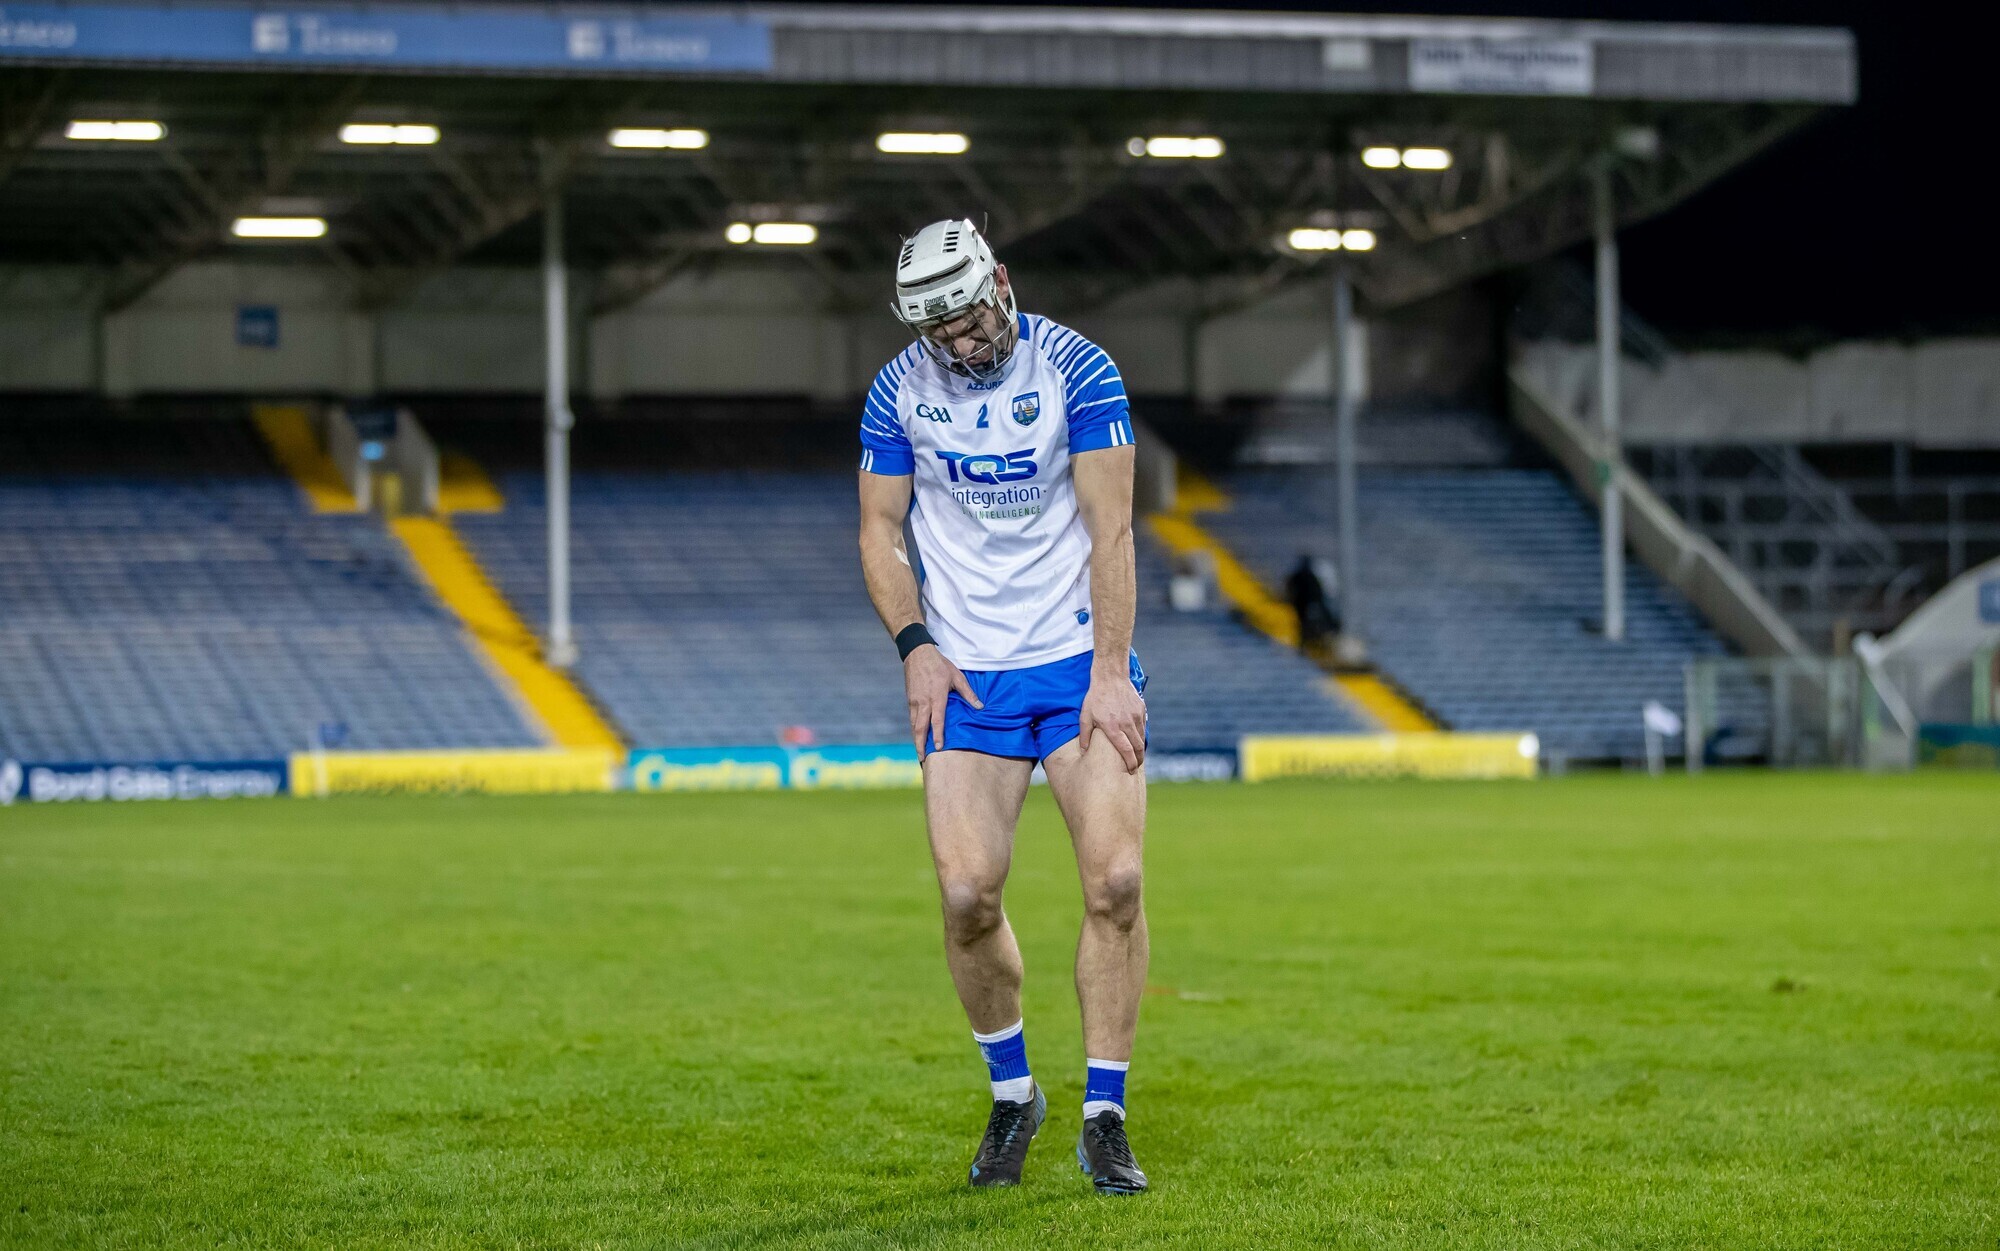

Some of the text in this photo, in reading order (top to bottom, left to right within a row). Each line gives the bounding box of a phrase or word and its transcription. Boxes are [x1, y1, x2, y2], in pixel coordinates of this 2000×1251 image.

[976, 403, 990, 429] 2
[934, 447, 1038, 485] TQS
[951, 486, 1041, 509] integration
[974, 505, 1042, 520] INTELLIGENCE
